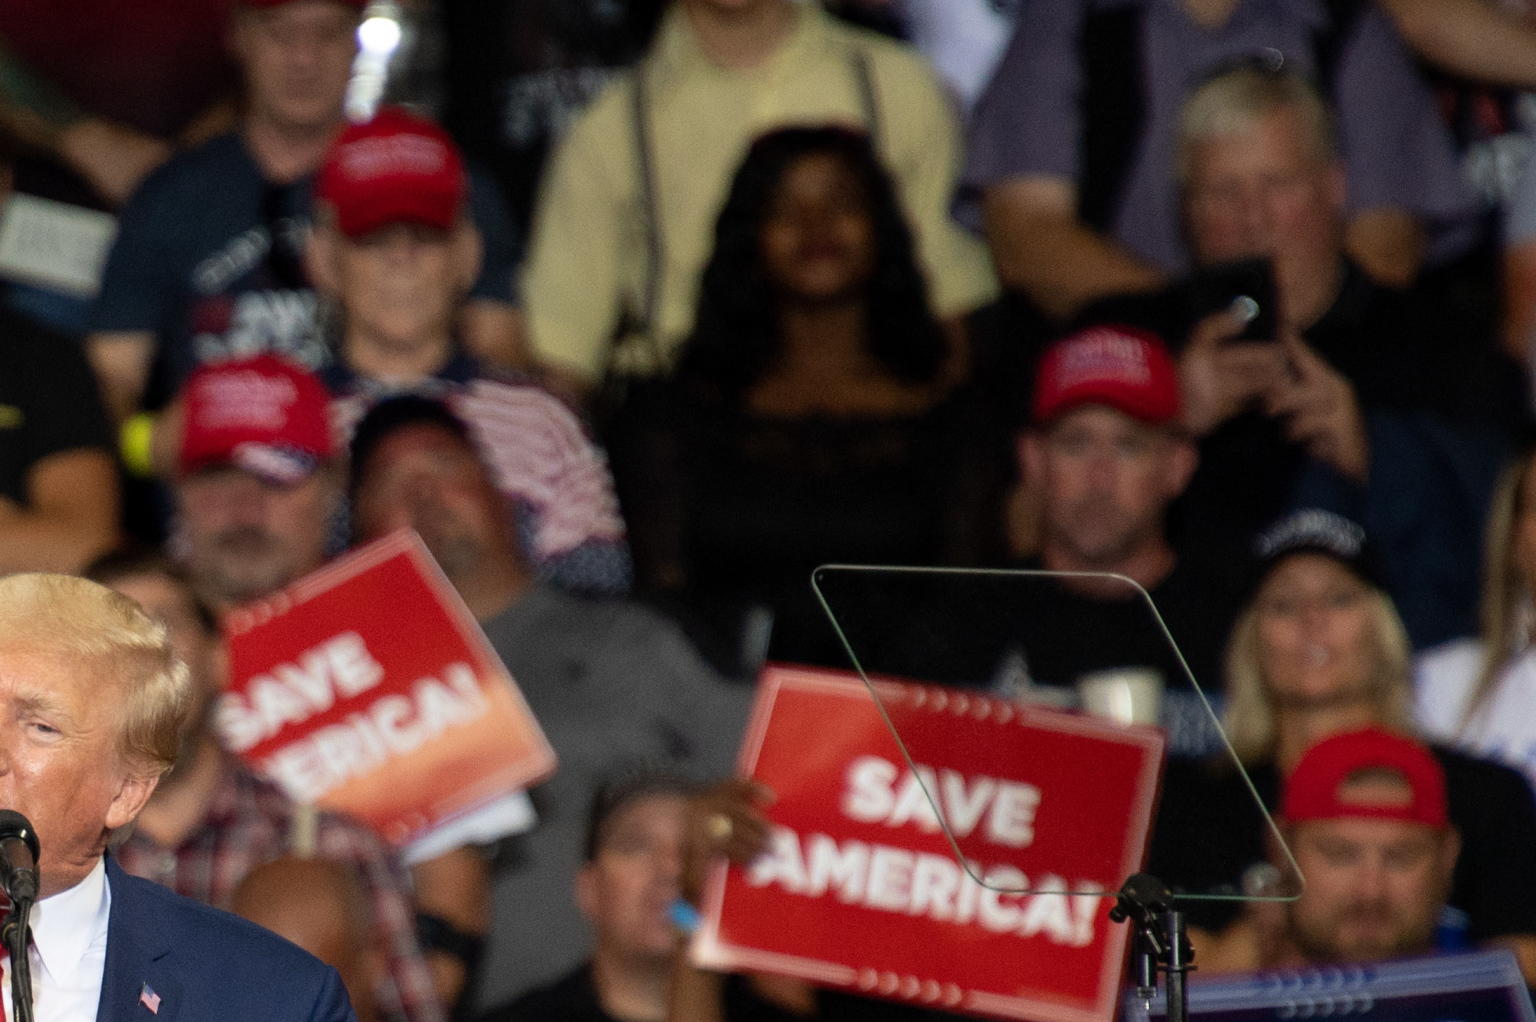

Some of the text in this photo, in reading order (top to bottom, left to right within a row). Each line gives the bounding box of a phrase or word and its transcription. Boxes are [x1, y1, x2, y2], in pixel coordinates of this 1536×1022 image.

[216, 629, 386, 752] SAVE
[262, 660, 489, 802] ERICA!
[842, 755, 1042, 848] SAVE
[746, 822, 1108, 947] AMERICA!
